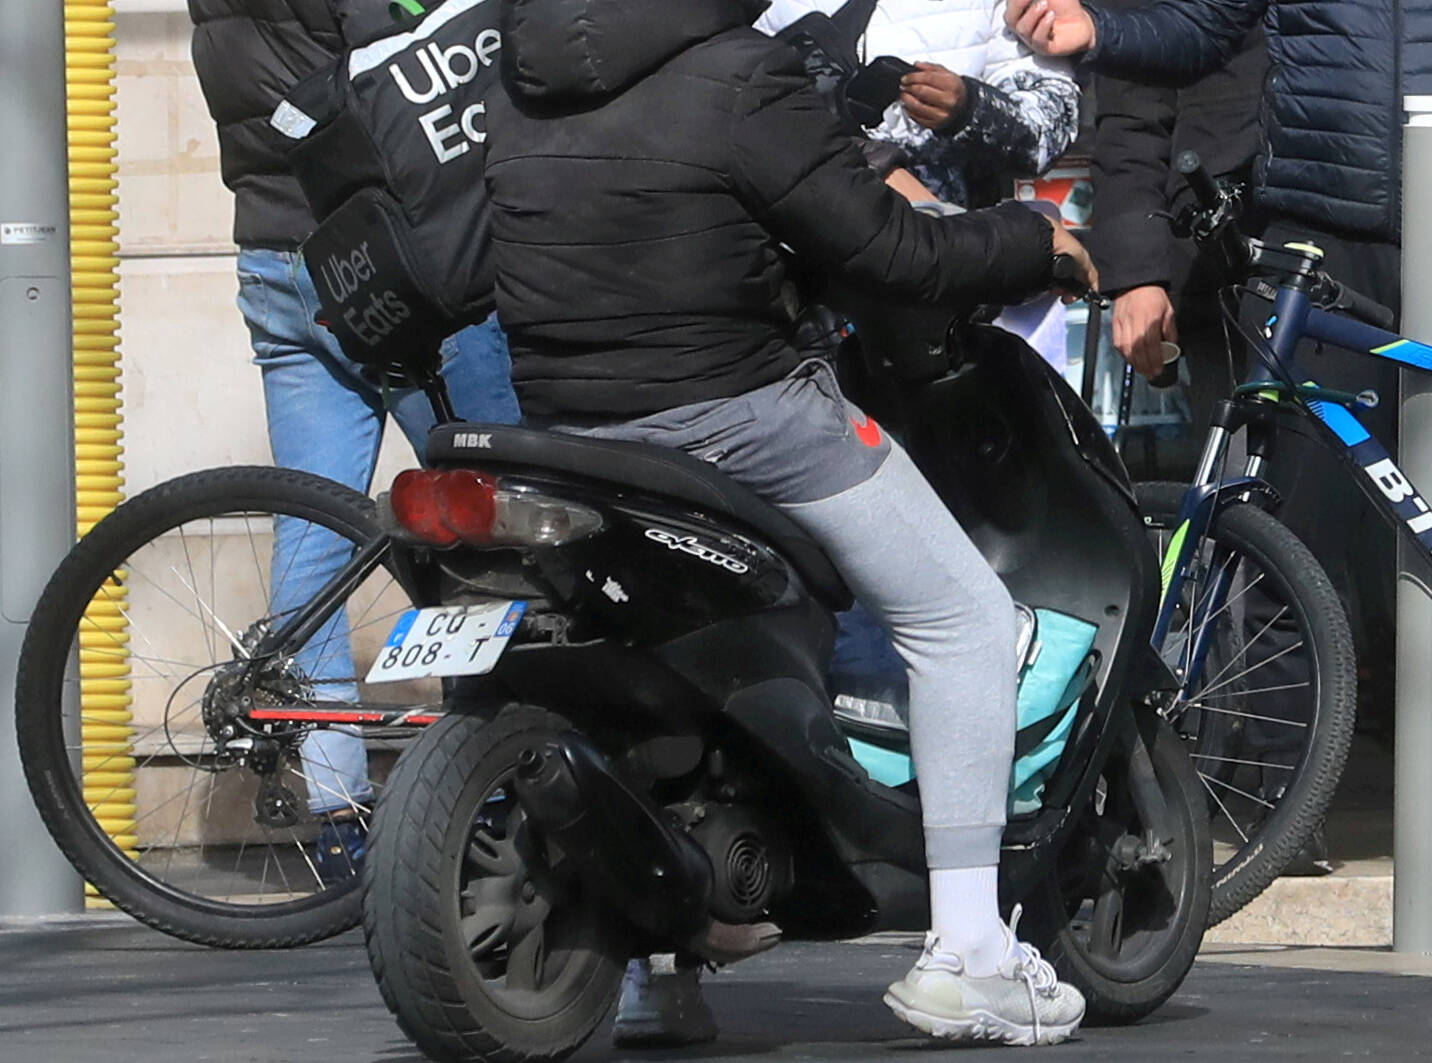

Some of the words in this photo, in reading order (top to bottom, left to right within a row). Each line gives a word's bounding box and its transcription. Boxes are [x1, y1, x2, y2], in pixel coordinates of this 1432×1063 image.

[388, 28, 502, 104] Ube
[320, 240, 377, 304] Uber
[343, 289, 411, 346] Eats
[453, 433, 492, 448] MBK
[497, 623, 513, 635] 06
